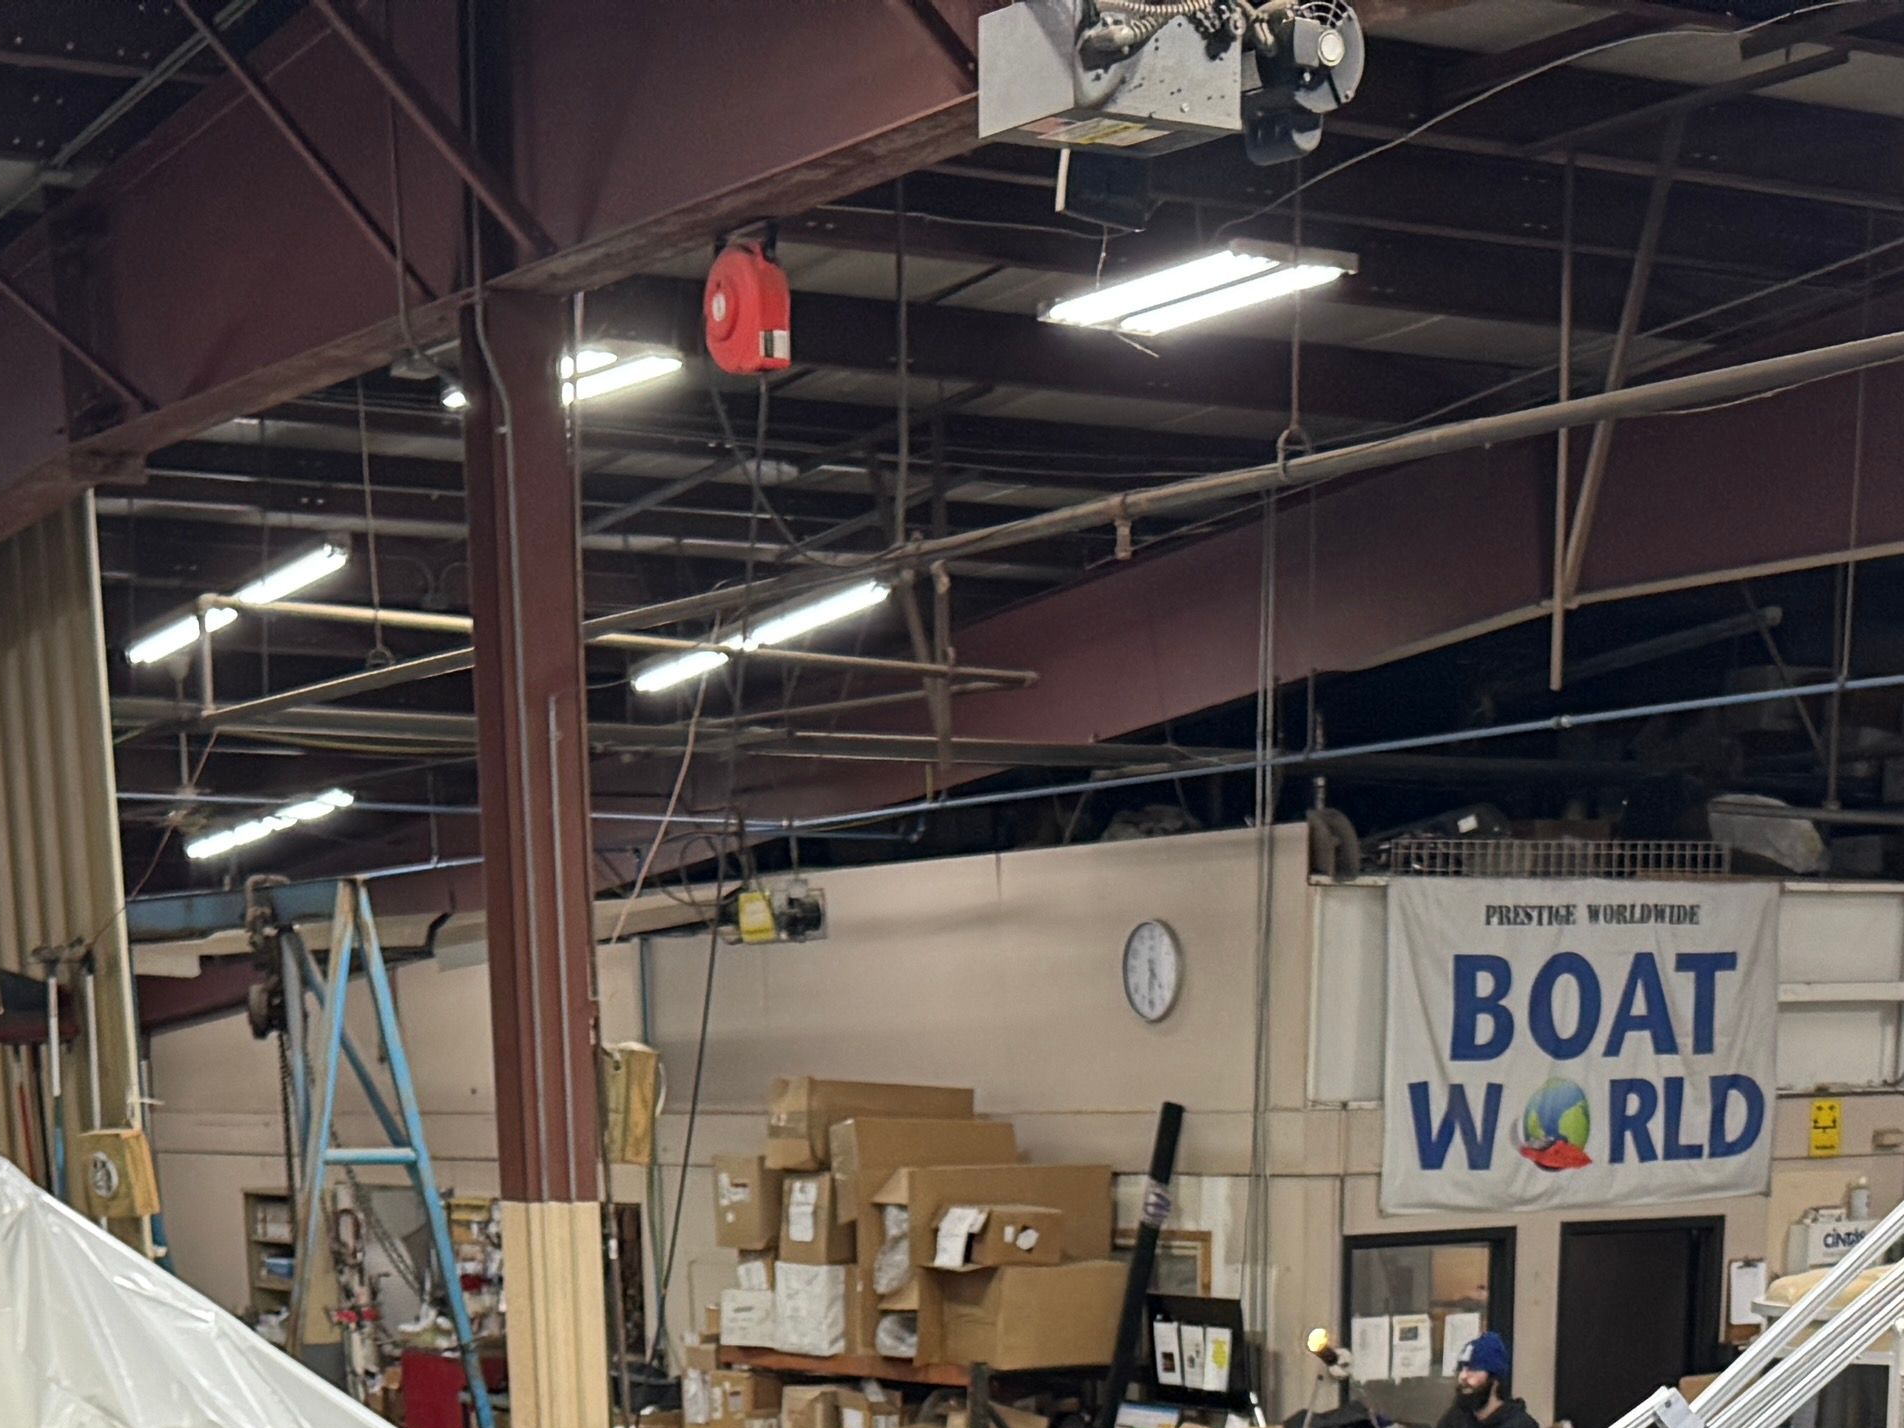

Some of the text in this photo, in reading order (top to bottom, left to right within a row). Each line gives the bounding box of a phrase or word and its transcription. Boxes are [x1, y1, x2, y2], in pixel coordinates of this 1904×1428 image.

[1484, 903, 1701, 926] PRESTIGE WORLDWIDE
[1450, 952, 1737, 1061] BOAT
